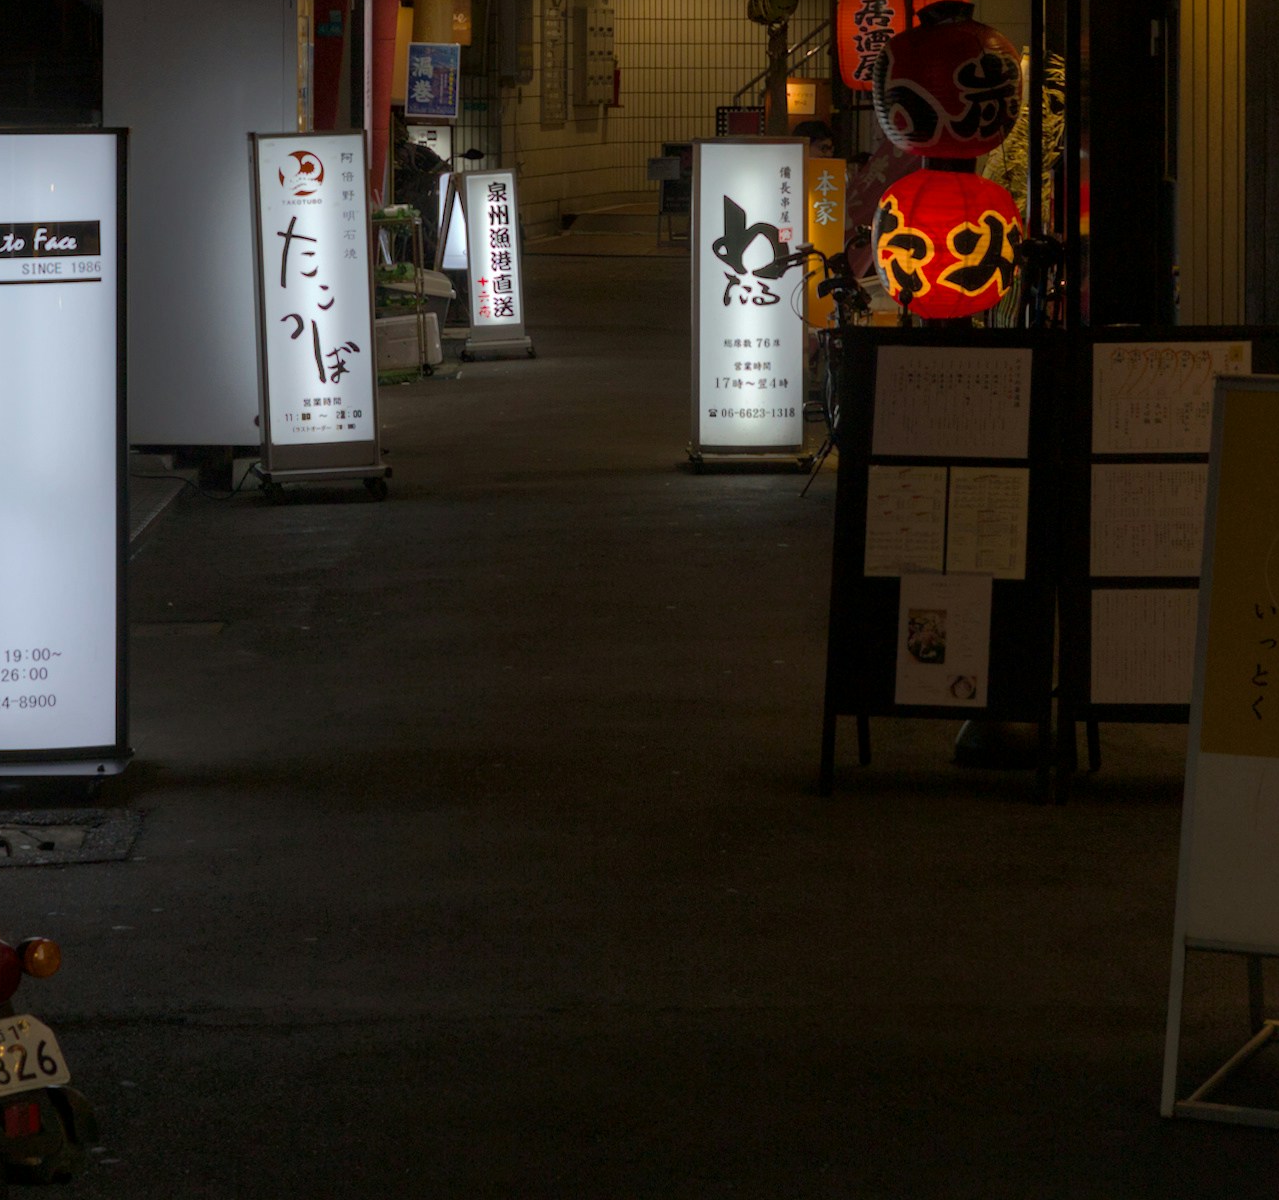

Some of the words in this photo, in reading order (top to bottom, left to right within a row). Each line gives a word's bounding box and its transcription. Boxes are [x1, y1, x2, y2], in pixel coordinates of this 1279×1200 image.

[779, 165, 792, 224] 備長串屋
[813, 170, 839, 226] 本家
[0, 232, 26, 252] to
[33, 227, 78, 252] Face
[21, 261, 63, 275] SINCE
[70, 260, 102, 274] 1986
[487, 180, 516, 319] 泉州漁港直送
[711, 194, 790, 307] わたる
[276, 215, 361, 385] たこつぼ
[733, 361, 773, 371] 営業時間
[0, 666, 48, 683] 26:00
[1251, 603, 1278, 721] いっとく
